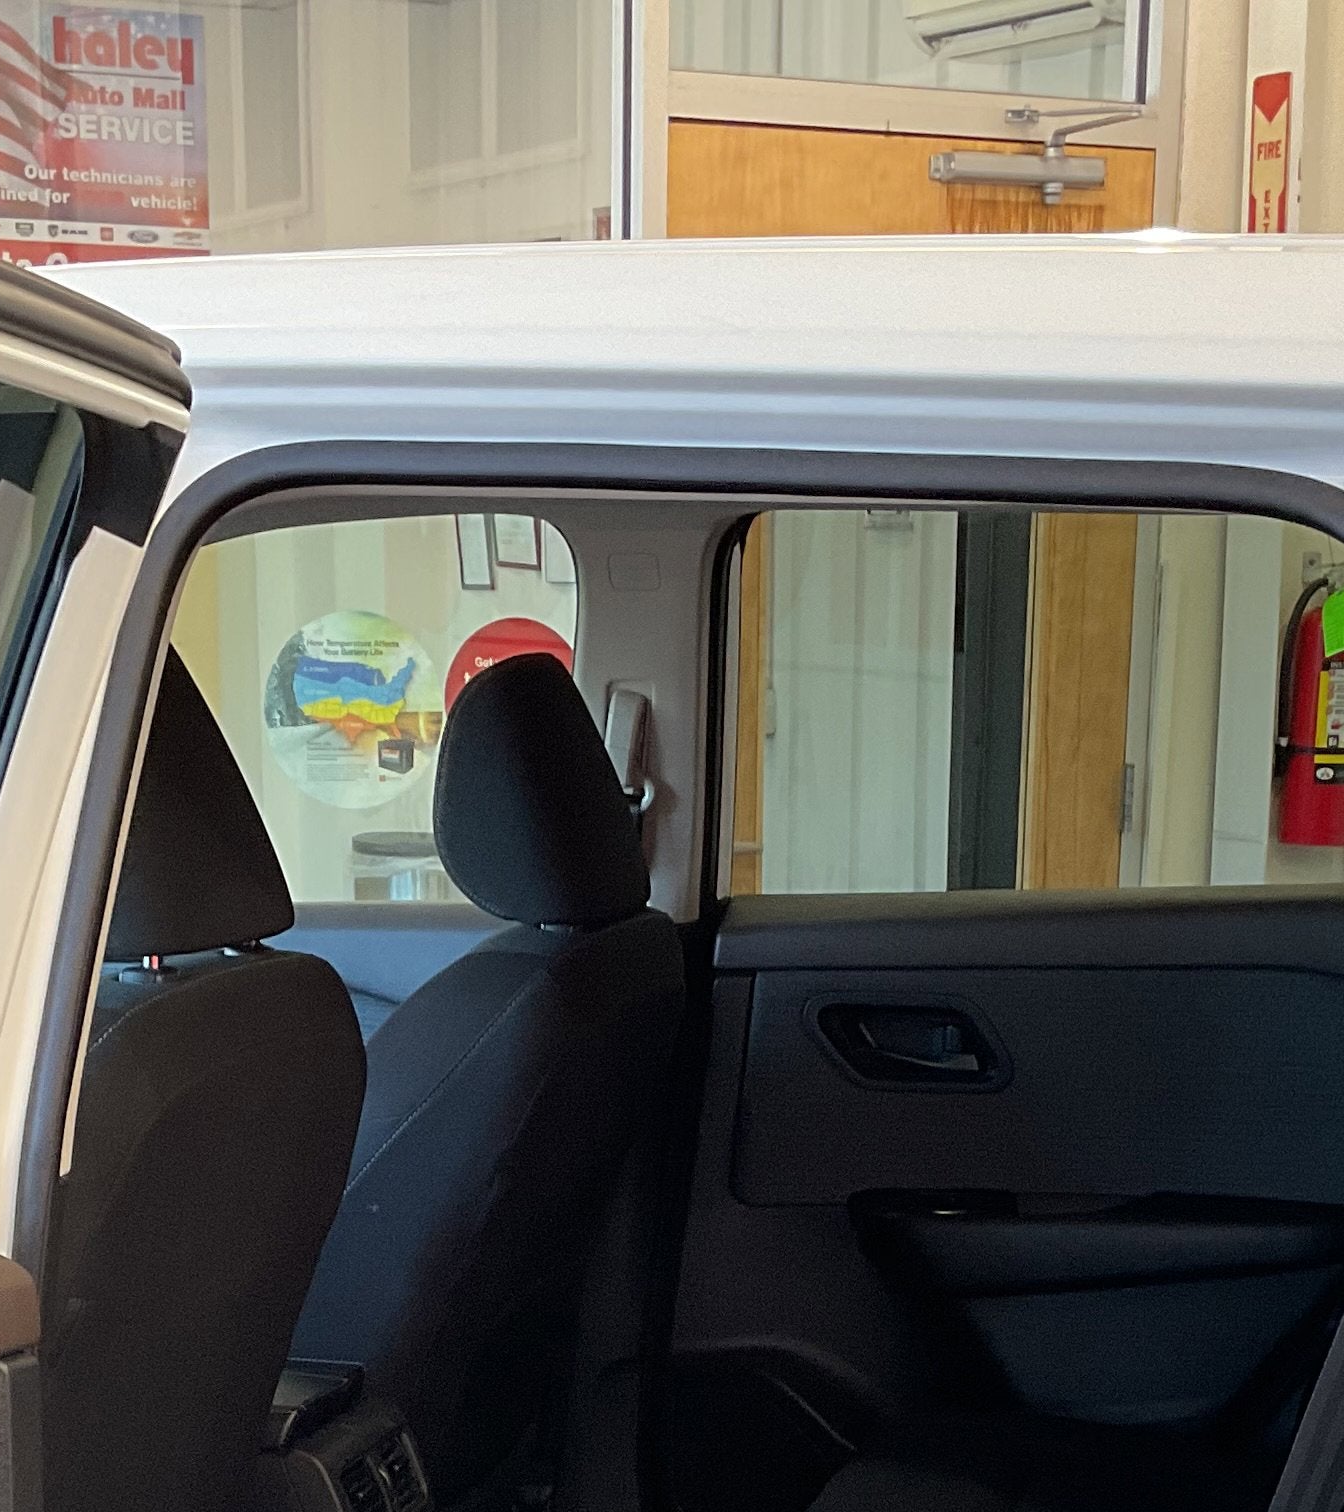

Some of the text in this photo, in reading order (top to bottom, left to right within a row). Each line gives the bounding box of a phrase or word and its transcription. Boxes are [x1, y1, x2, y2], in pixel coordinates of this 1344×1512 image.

[53, 16, 194, 85] haley
[133, 87, 185, 110] Mall
[58, 112, 194, 146] SERVICE
[1257, 140, 1282, 161] FIRE
[24, 164, 197, 188] Our technicians are
[45, 191, 70, 204] for
[131, 195, 198, 212] vehicle!
